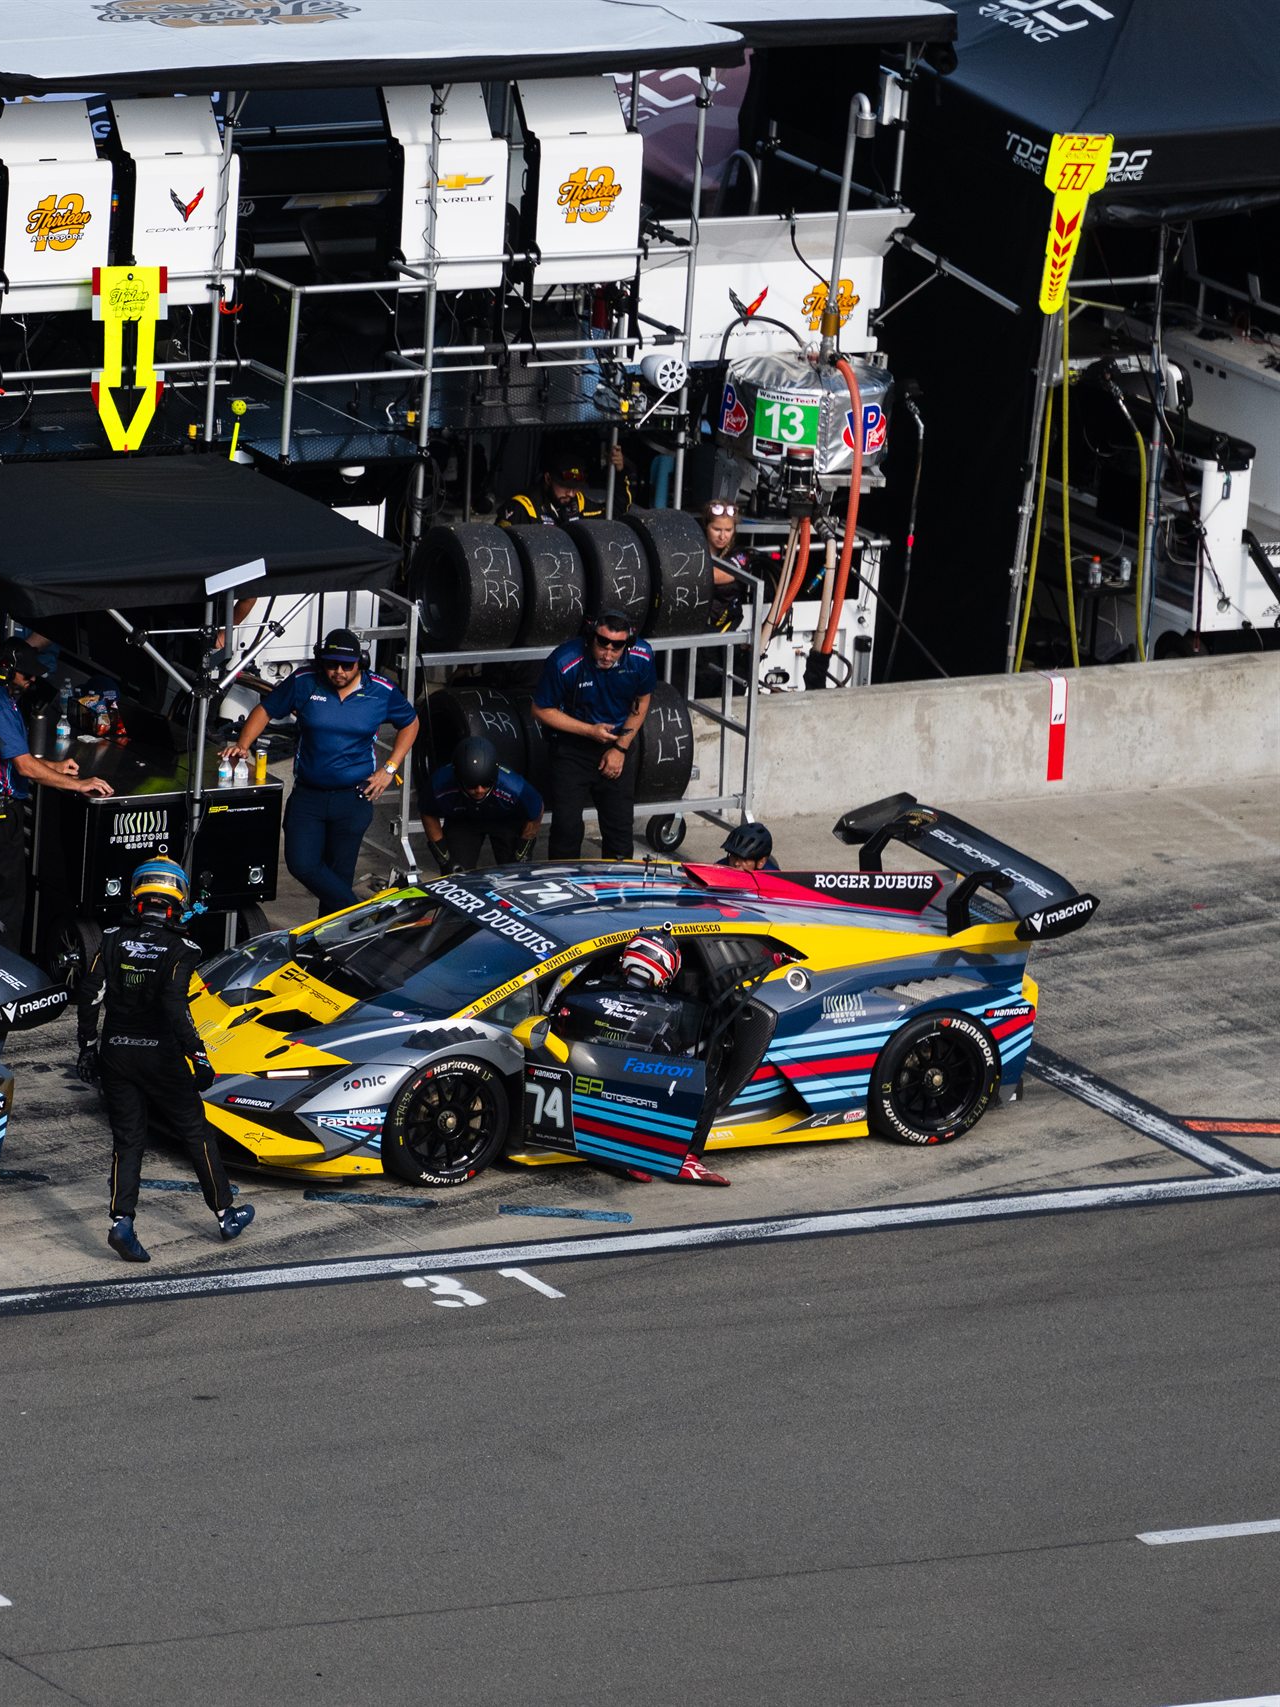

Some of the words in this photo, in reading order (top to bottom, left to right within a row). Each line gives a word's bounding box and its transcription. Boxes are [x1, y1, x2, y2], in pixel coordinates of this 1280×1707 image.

[979, 3, 1059, 43] RACING
[1057, 163, 1095, 190] 11
[557, 180, 623, 206] Thirteen
[25, 204, 92, 234] Thirteen
[30, 232, 84, 243] AUTOSPORT
[760, 390, 817, 405] WeatherTech
[765, 403, 805, 443] 13
[474, 546, 511, 575] 27
[540, 550, 574, 579] 27
[608, 541, 641, 570] 27
[671, 543, 705, 577] 27
[483, 578, 520, 609] RR
[548, 583, 583, 615] FR
[676, 585, 709, 608] RL
[480, 710, 517, 739] RR
[651, 707, 683, 732] 74
[657, 734, 689, 764] LF
[110, 832, 170, 844] FREESTONE
[125, 841, 154, 850] GROVE
[929, 827, 1002, 868] SQUADRA
[999, 866, 1054, 899] CORSE
[814, 873, 871, 889] ROGER
[873, 874, 934, 890] DUBUIS
[426, 879, 486, 914] ROGER
[477, 908, 558, 955] DUBUIS
[1045, 900, 1094, 925] macron
[672, 924, 721, 934] FRANCISCO
[472, 1003, 483, 1015] D.
[482, 979, 521, 1008] MORILLO
[534, 962, 546, 976] P.
[544, 946, 583, 972] WHITING
[19, 989, 69, 1016] macron
[993, 1006, 1031, 1018] HANKOOK
[622, 1056, 694, 1079] Fastron
[574, 1075, 604, 1095] SP
[233, 1095, 272, 1108] HANKOOK
[349, 1107, 382, 1115] PERTAMINA
[526, 1082, 565, 1129] 74
[600, 1090, 658, 1110] MOTORSPORTS
[316, 1113, 382, 1128] Fastron
